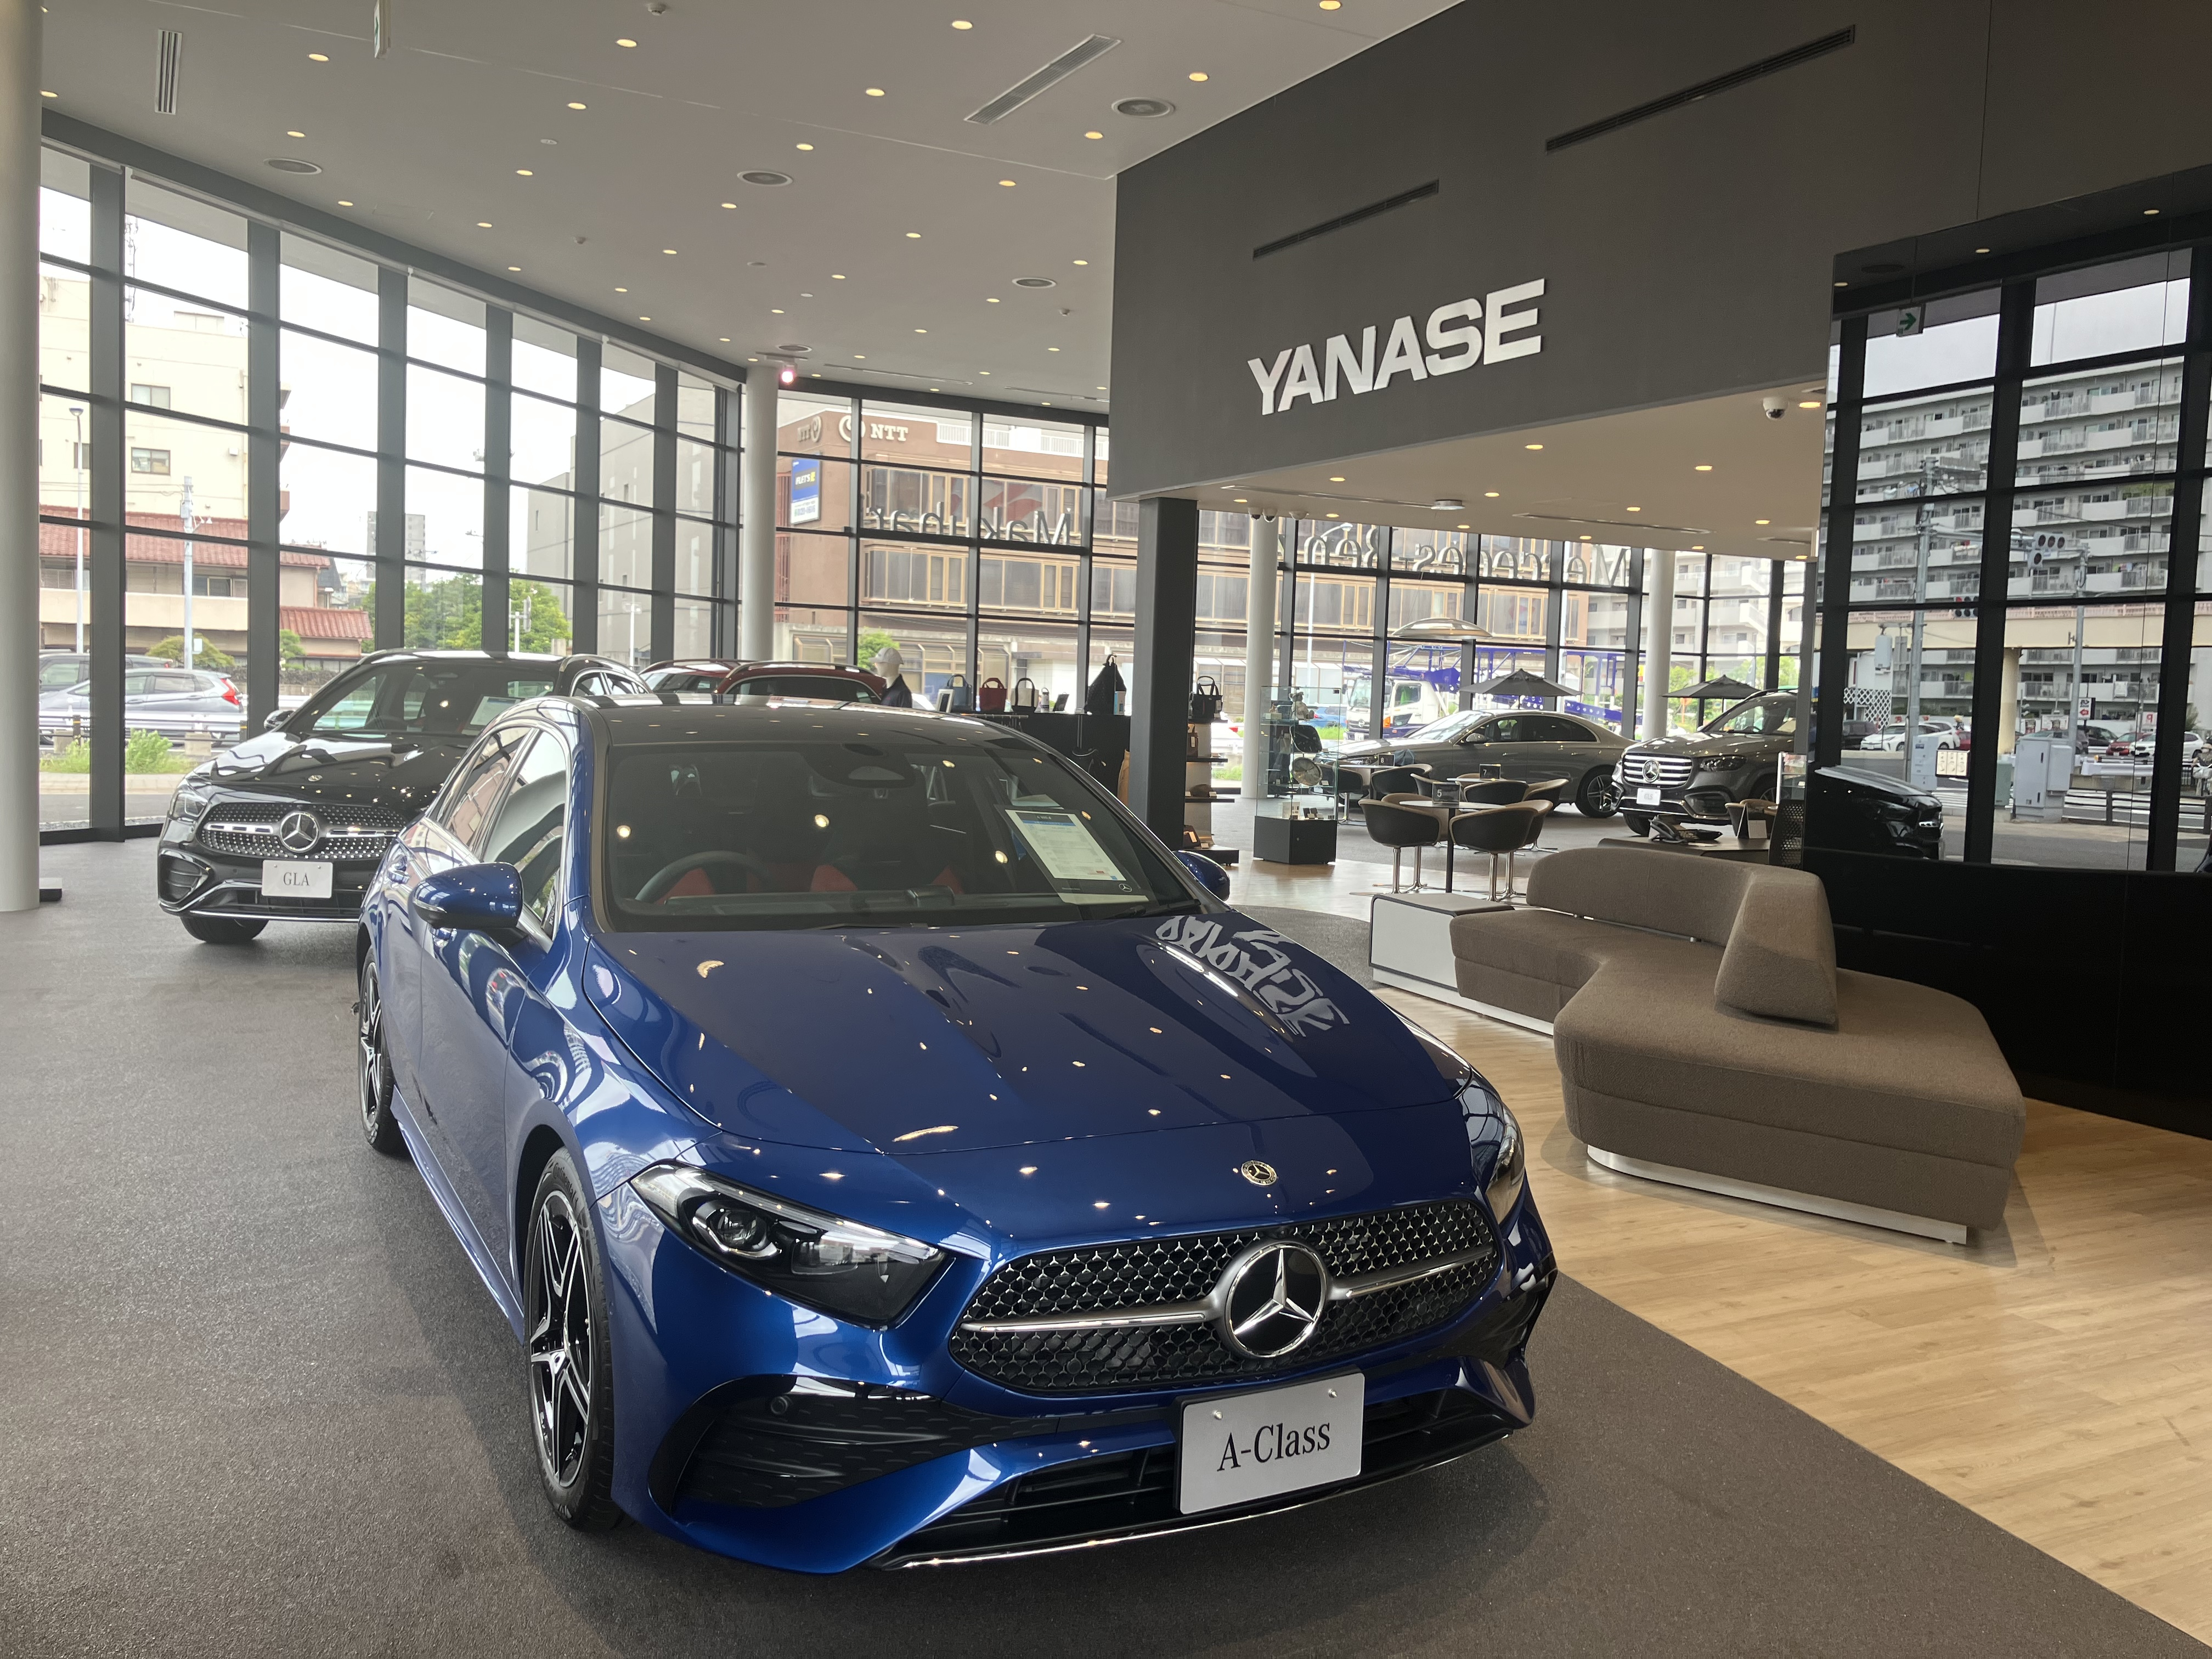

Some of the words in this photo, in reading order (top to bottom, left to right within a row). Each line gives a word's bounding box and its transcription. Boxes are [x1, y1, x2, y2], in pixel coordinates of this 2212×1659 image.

[1247, 278, 1545, 416] YANASE
[870, 423, 909, 442] NTT
[1437, 789, 1442, 797] 5
[283, 872, 311, 887] GLA
[1216, 1422, 1330, 1472] A-Class
